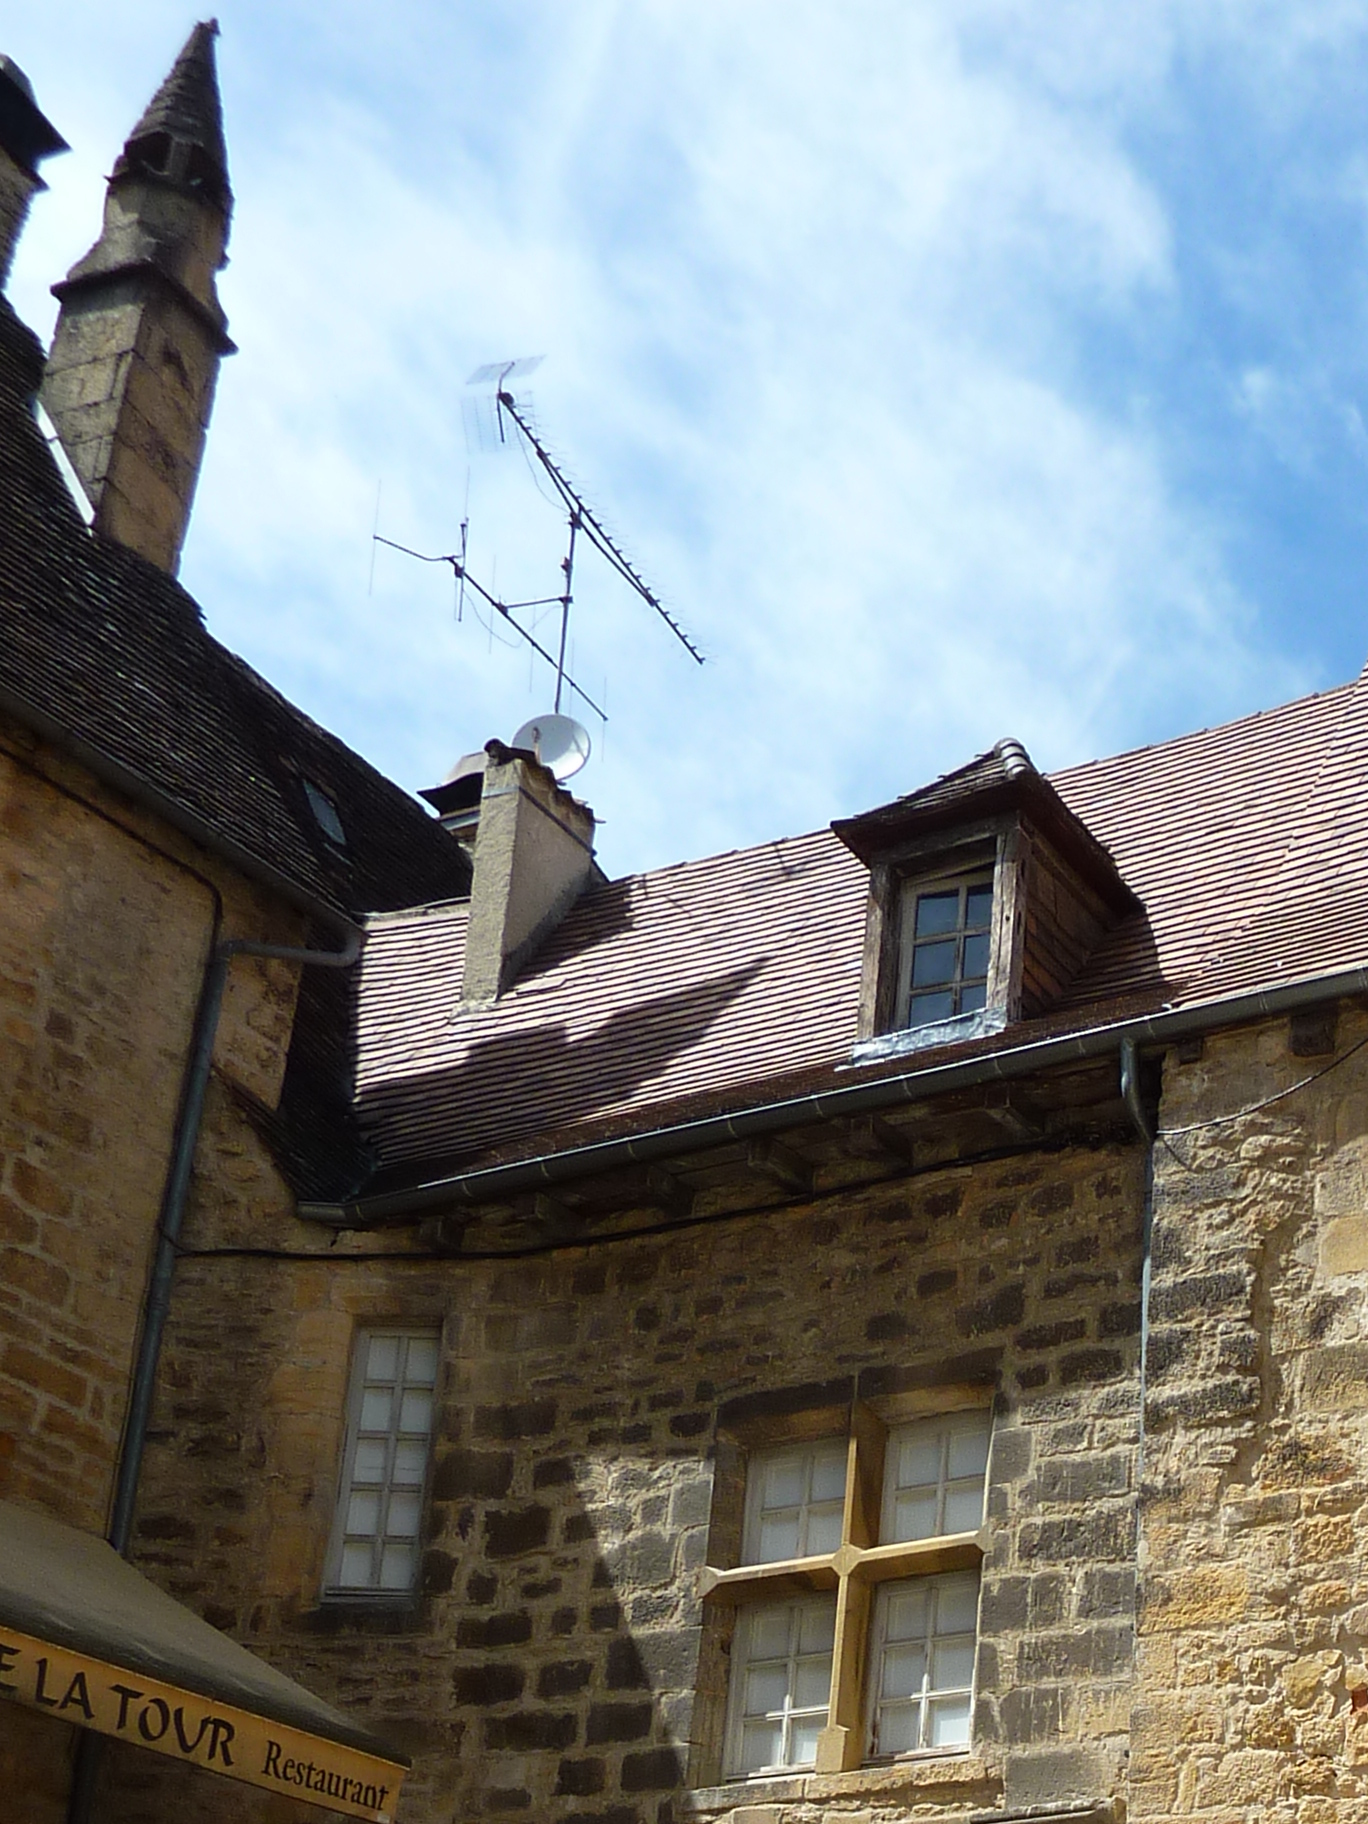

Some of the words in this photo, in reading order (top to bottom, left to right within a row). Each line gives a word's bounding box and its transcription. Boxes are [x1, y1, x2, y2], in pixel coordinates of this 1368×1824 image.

[35, 1658, 95, 1720] LA
[110, 1684, 235, 1767] TOUR
[261, 1739, 390, 1811] Restaurant
